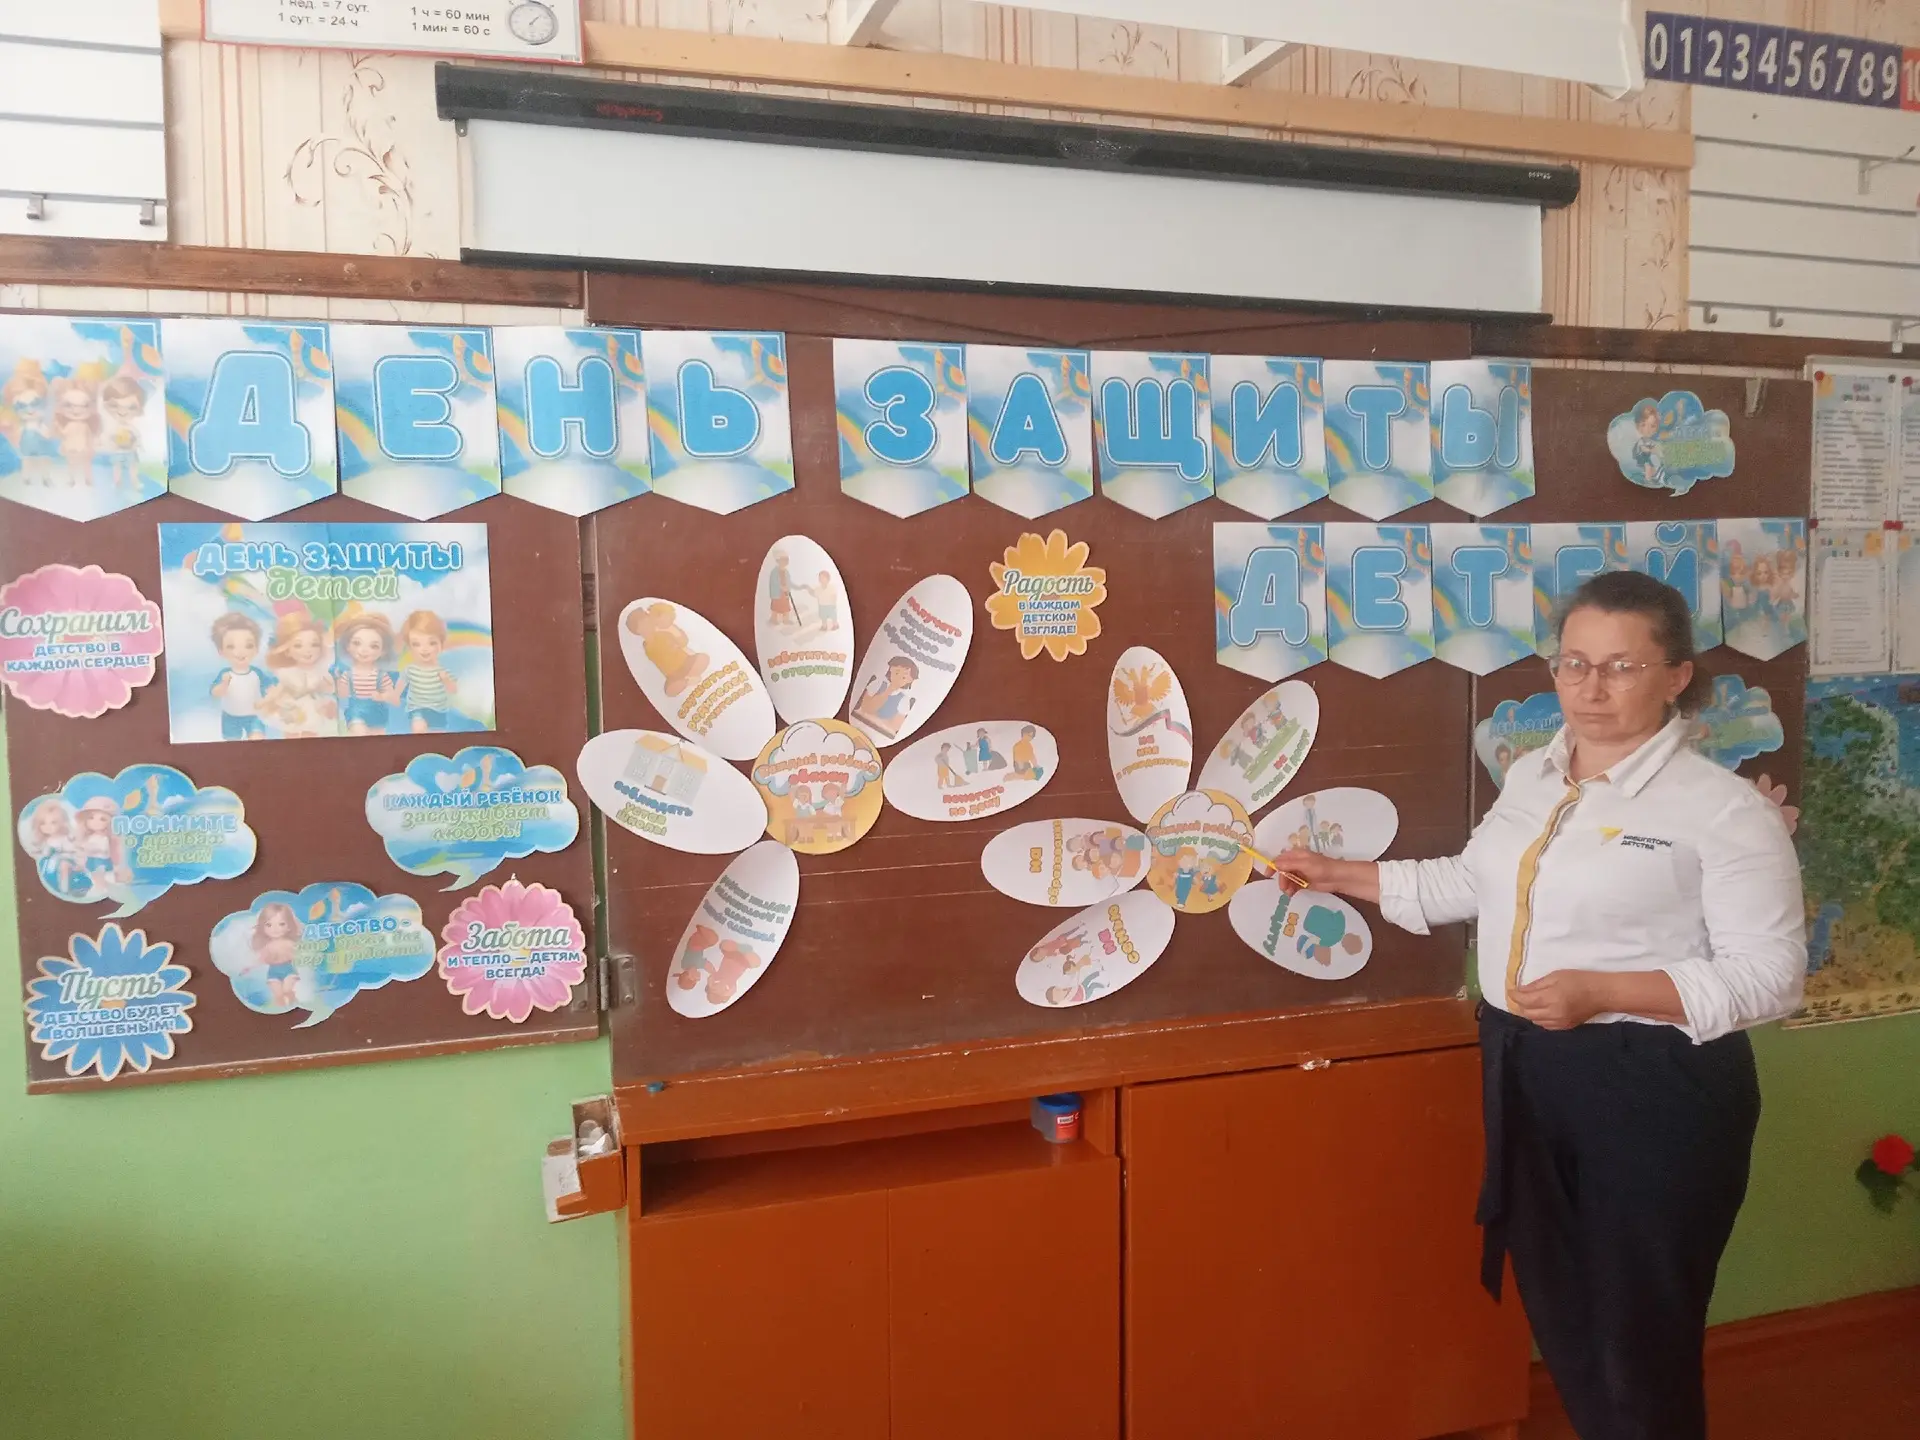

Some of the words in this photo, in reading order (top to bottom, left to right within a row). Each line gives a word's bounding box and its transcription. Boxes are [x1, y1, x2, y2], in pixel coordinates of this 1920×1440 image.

[334, 0, 342, 10] 7
[346, 3, 370, 14] сут.
[411, 6, 417, 16] 1
[445, 9, 462, 20] 60
[465, 12, 490, 21] мин
[278, 12, 284, 22] 1
[330, 16, 346, 26] 24
[412, 22, 418, 31] 1
[422, 24, 448, 33] мин
[463, 25, 480, 36] 60
[483, 28, 490, 36] с
[1650, 23, 1668, 71] 0
[1680, 27, 1693, 74] 1
[1704, 30, 1723, 78] 2
[1731, 33, 1751, 81] 3
[1757, 37, 1778, 84] 4
[1784, 41, 1804, 87] 5
[1808, 44, 1828, 91] 6
[1834, 48, 1854, 94] 7
[1857, 51, 1876, 97] 8
[1881, 55, 1899, 101] 9
[190, 350, 761, 477] ДЕНЬ
[863, 366, 1520, 483] ЗАЩИТЫ
[194, 543, 299, 576] ДЕНЬ
[303, 542, 463, 572] ЗАЩИТЫ
[266, 565, 398, 600] детей
[1004, 570, 1094, 601] Радость
[1019, 602, 1026, 610] В
[1029, 601, 1081, 611] КАЖДОМ
[0, 608, 150, 643] Сохраним
[1023, 613, 1077, 624] ДЕТСКОМ
[1023, 625, 1076, 635] ВЗГЛЯДЕ!
[35, 643, 106, 657] ДЕТСТВО
[109, 643, 121, 652] В
[6, 658, 80, 671] КАЖДОМ
[84, 655, 150, 669] СЕРДЦЕ!
[384, 788, 473, 809] КАЖДЫЙ
[477, 787, 562, 808] РЕБЁНОК
[113, 814, 238, 835] ПОМНИТЕ
[1620, 840, 1655, 851] ДЕТСТВА
[1623, 834, 1673, 847] НАВИГАТОРЫ
[302, 917, 397, 940] ДЕТСТВО
[463, 923, 570, 950] Забота
[448, 957, 458, 966] И
[462, 955, 511, 966] ТЕПЛО
[530, 952, 580, 963] ДЕТЯМ
[486, 967, 545, 978] ВСЕГДА!
[60, 970, 162, 1010] Пусть
[44, 1010, 121, 1026] ДЕТСТВО
[126, 1004, 180, 1020] БУДЕТ
[52, 1019, 175, 1039] ВОЛШЕБНЫМ!
